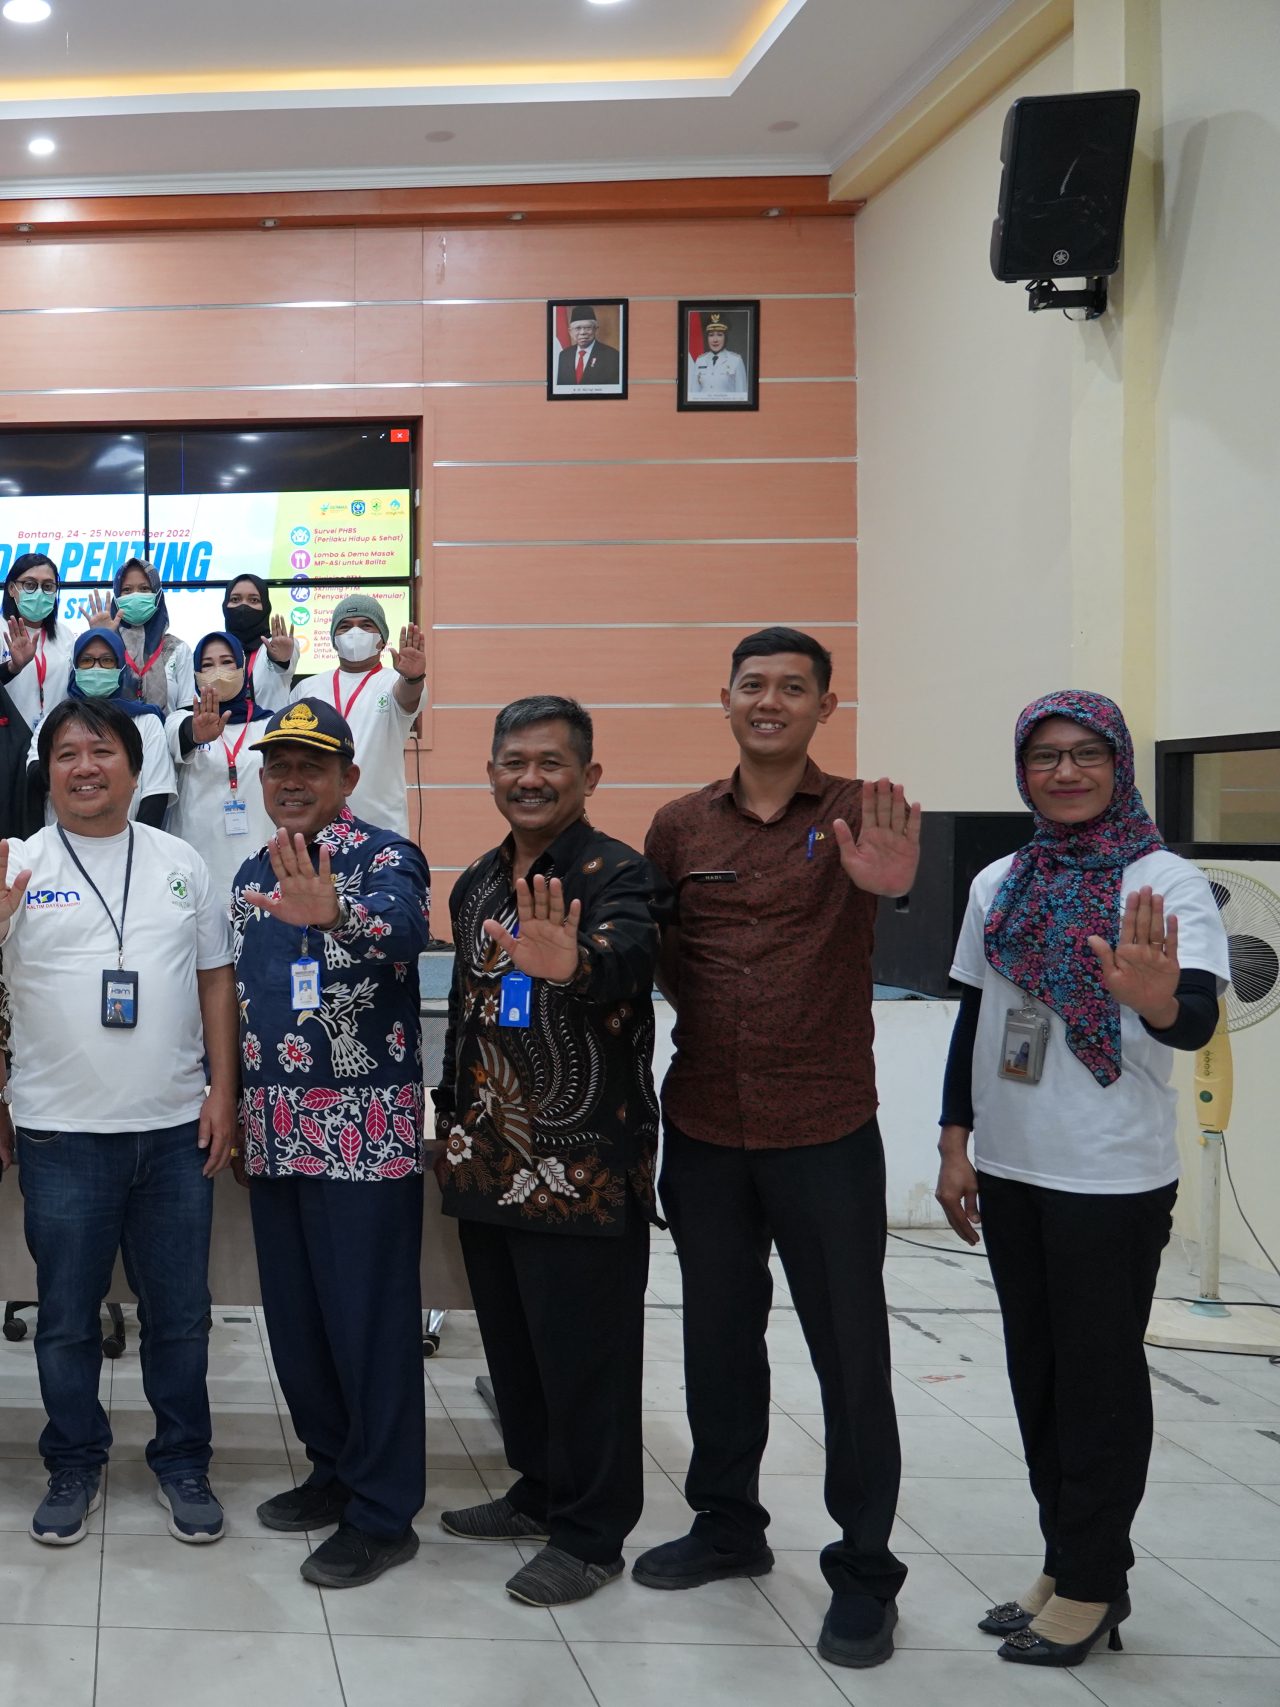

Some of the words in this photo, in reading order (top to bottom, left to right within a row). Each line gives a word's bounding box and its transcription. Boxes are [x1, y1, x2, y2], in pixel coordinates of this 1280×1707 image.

[18, 531, 63, 540] Bontang,
[66, 530, 79, 538] 24
[89, 529, 102, 537] 25
[104, 529, 164, 538] November
[166, 529, 191, 537] 2022
[314, 536, 347, 544] (Perilaku
[348, 535, 370, 543] Hidup
[379, 534, 404, 542] Sehat)
[314, 616, 332, 624] Lingk
